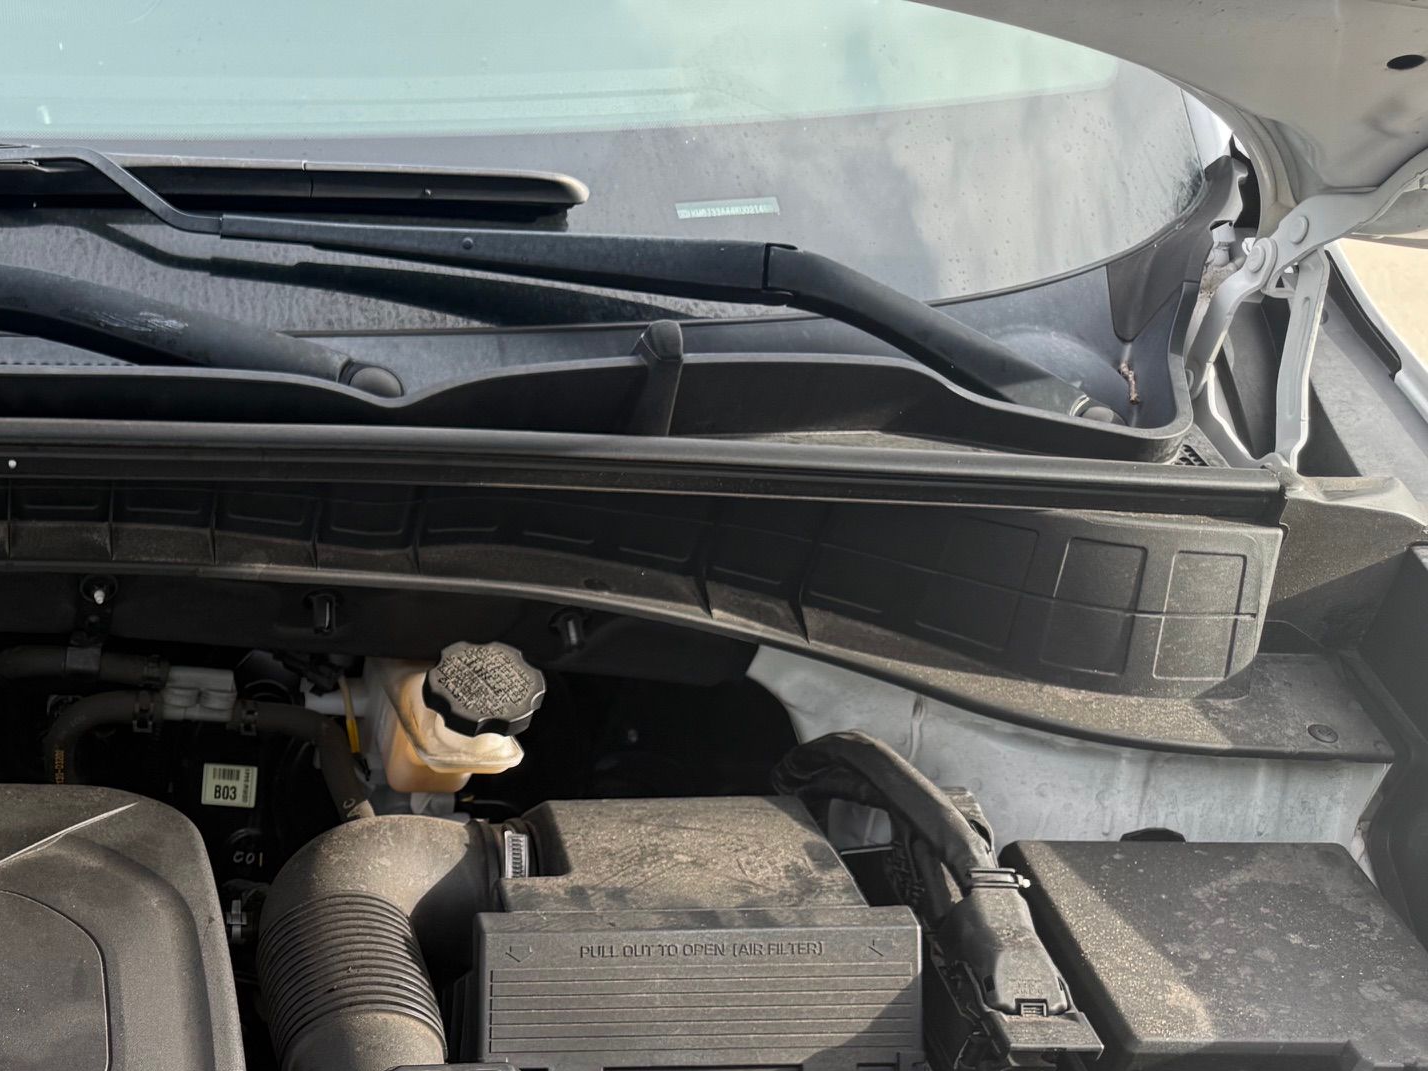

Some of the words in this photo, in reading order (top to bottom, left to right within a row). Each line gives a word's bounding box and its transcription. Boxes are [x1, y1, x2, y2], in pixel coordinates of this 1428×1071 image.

[214, 785, 237, 800] B03
[580, 945, 618, 958] PULL
[622, 944, 653, 957] OUT
[658, 944, 678, 957] TO
[683, 943, 725, 956] OPEN
